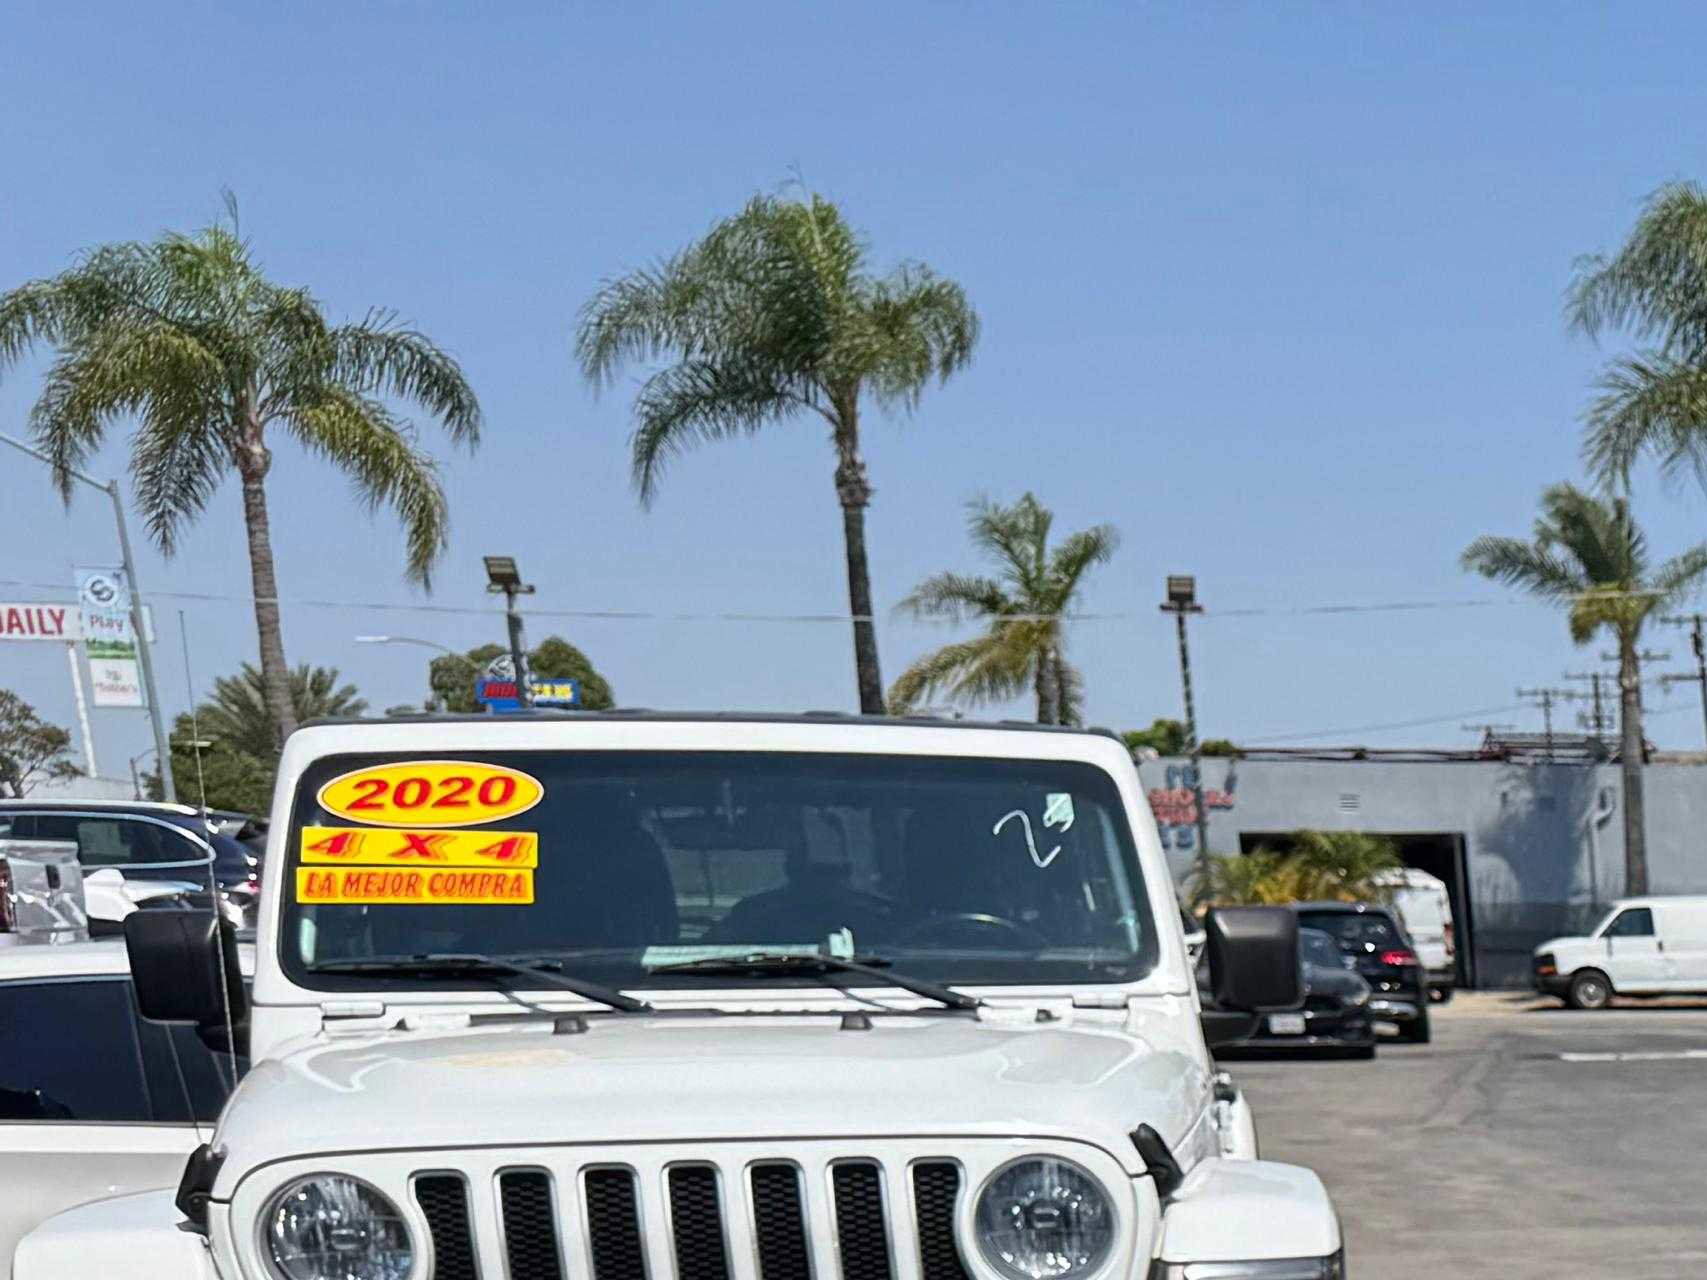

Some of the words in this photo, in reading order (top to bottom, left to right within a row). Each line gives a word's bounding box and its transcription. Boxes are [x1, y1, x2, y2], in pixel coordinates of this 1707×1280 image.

[0, 608, 66, 635] AILY
[346, 776, 517, 810] 2020
[305, 831, 362, 858] 4
[475, 837, 530, 863] 4
[303, 872, 338, 898] LA
[342, 872, 422, 898] MEJOR
[428, 873, 526, 898] COMPRA
